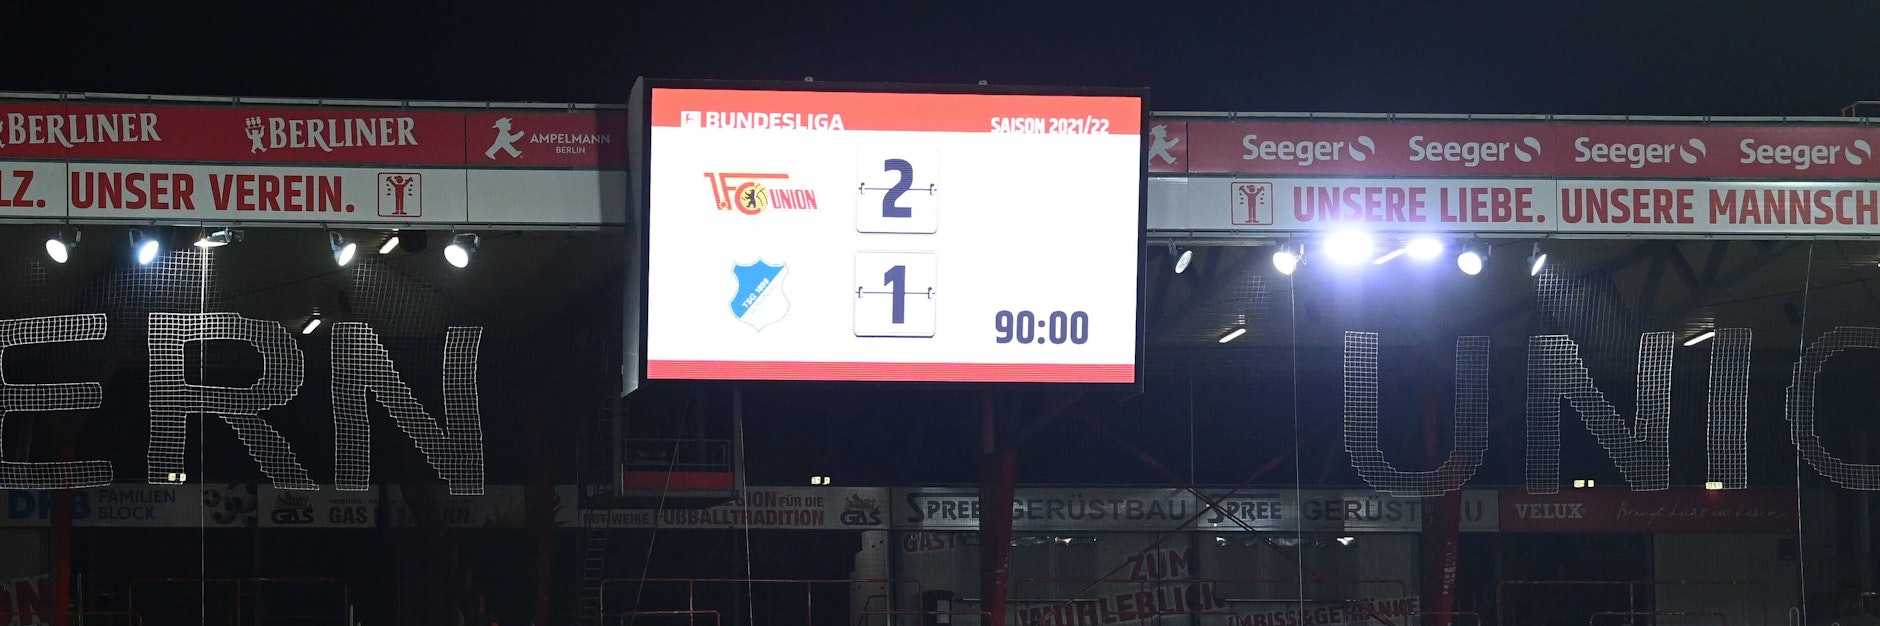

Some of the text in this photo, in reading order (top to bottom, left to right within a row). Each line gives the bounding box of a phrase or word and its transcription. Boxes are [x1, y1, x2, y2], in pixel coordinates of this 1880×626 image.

[8, 112, 162, 148] BERLINER
[269, 116, 419, 152] BERLINER
[706, 111, 844, 131] BUNDESLIGA
[990, 115, 1109, 135] SAISON 2021/22
[530, 133, 610, 144] AMPELMANN
[556, 146, 586, 154] BERLIN
[1242, 134, 1344, 166] Seeger
[1408, 135, 1510, 167] Seeger
[1574, 136, 1675, 169] Seeger
[1739, 138, 1840, 170] Seeger
[71, 171, 195, 210] UNSER
[208, 174, 355, 213] VEREIN.
[769, 189, 818, 210] UNION
[882, 158, 913, 218] 2
[1293, 186, 1878, 225] UNSERE LIEBE. UNSERE MANNSCH
[884, 265, 905, 324] 1
[995, 310, 1089, 345] 90:00
[99, 488, 176, 504] FAMILIEN
[1515, 503, 1583, 519] VELUX
[99, 505, 156, 520] BLOCK
[329, 506, 367, 523] GAS
